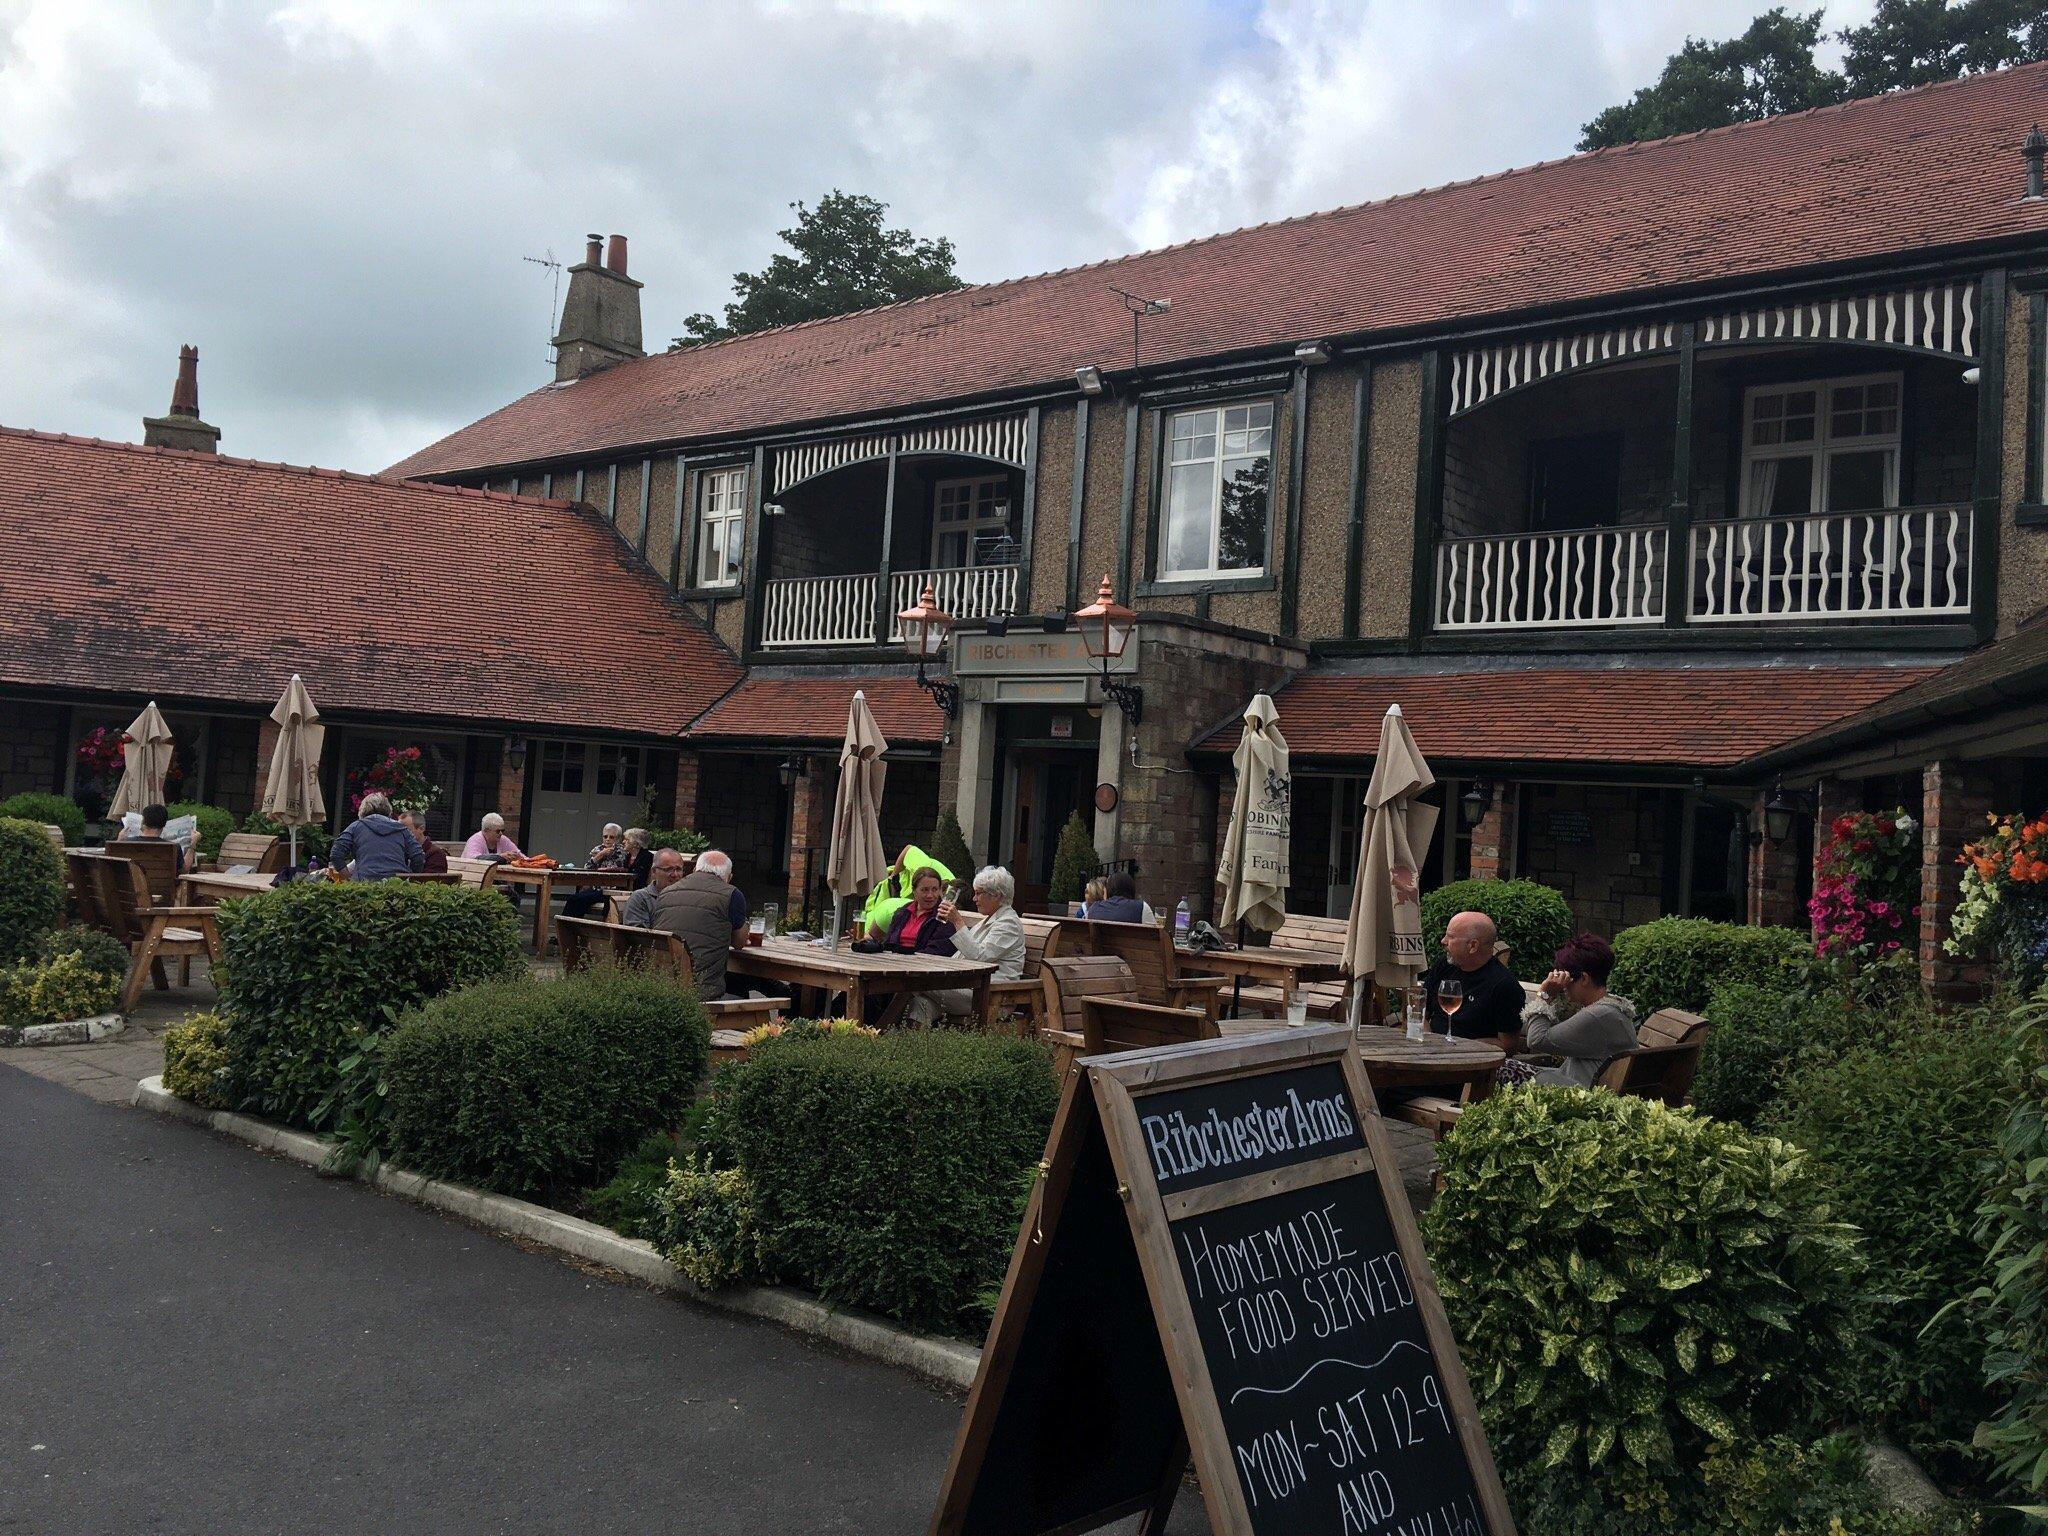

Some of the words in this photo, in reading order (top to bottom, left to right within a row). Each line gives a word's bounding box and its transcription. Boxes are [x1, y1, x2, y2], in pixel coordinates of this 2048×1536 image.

[968, 642, 1068, 661] RIBCHESTER
[1182, 1203, 1358, 1299] HOMEMADE
[1217, 1291, 1296, 1360] FOOD
[1303, 1250, 1415, 1339] SERVED
[1382, 1375, 1452, 1450] 12-9
[1337, 1470, 1395, 1536] AND
